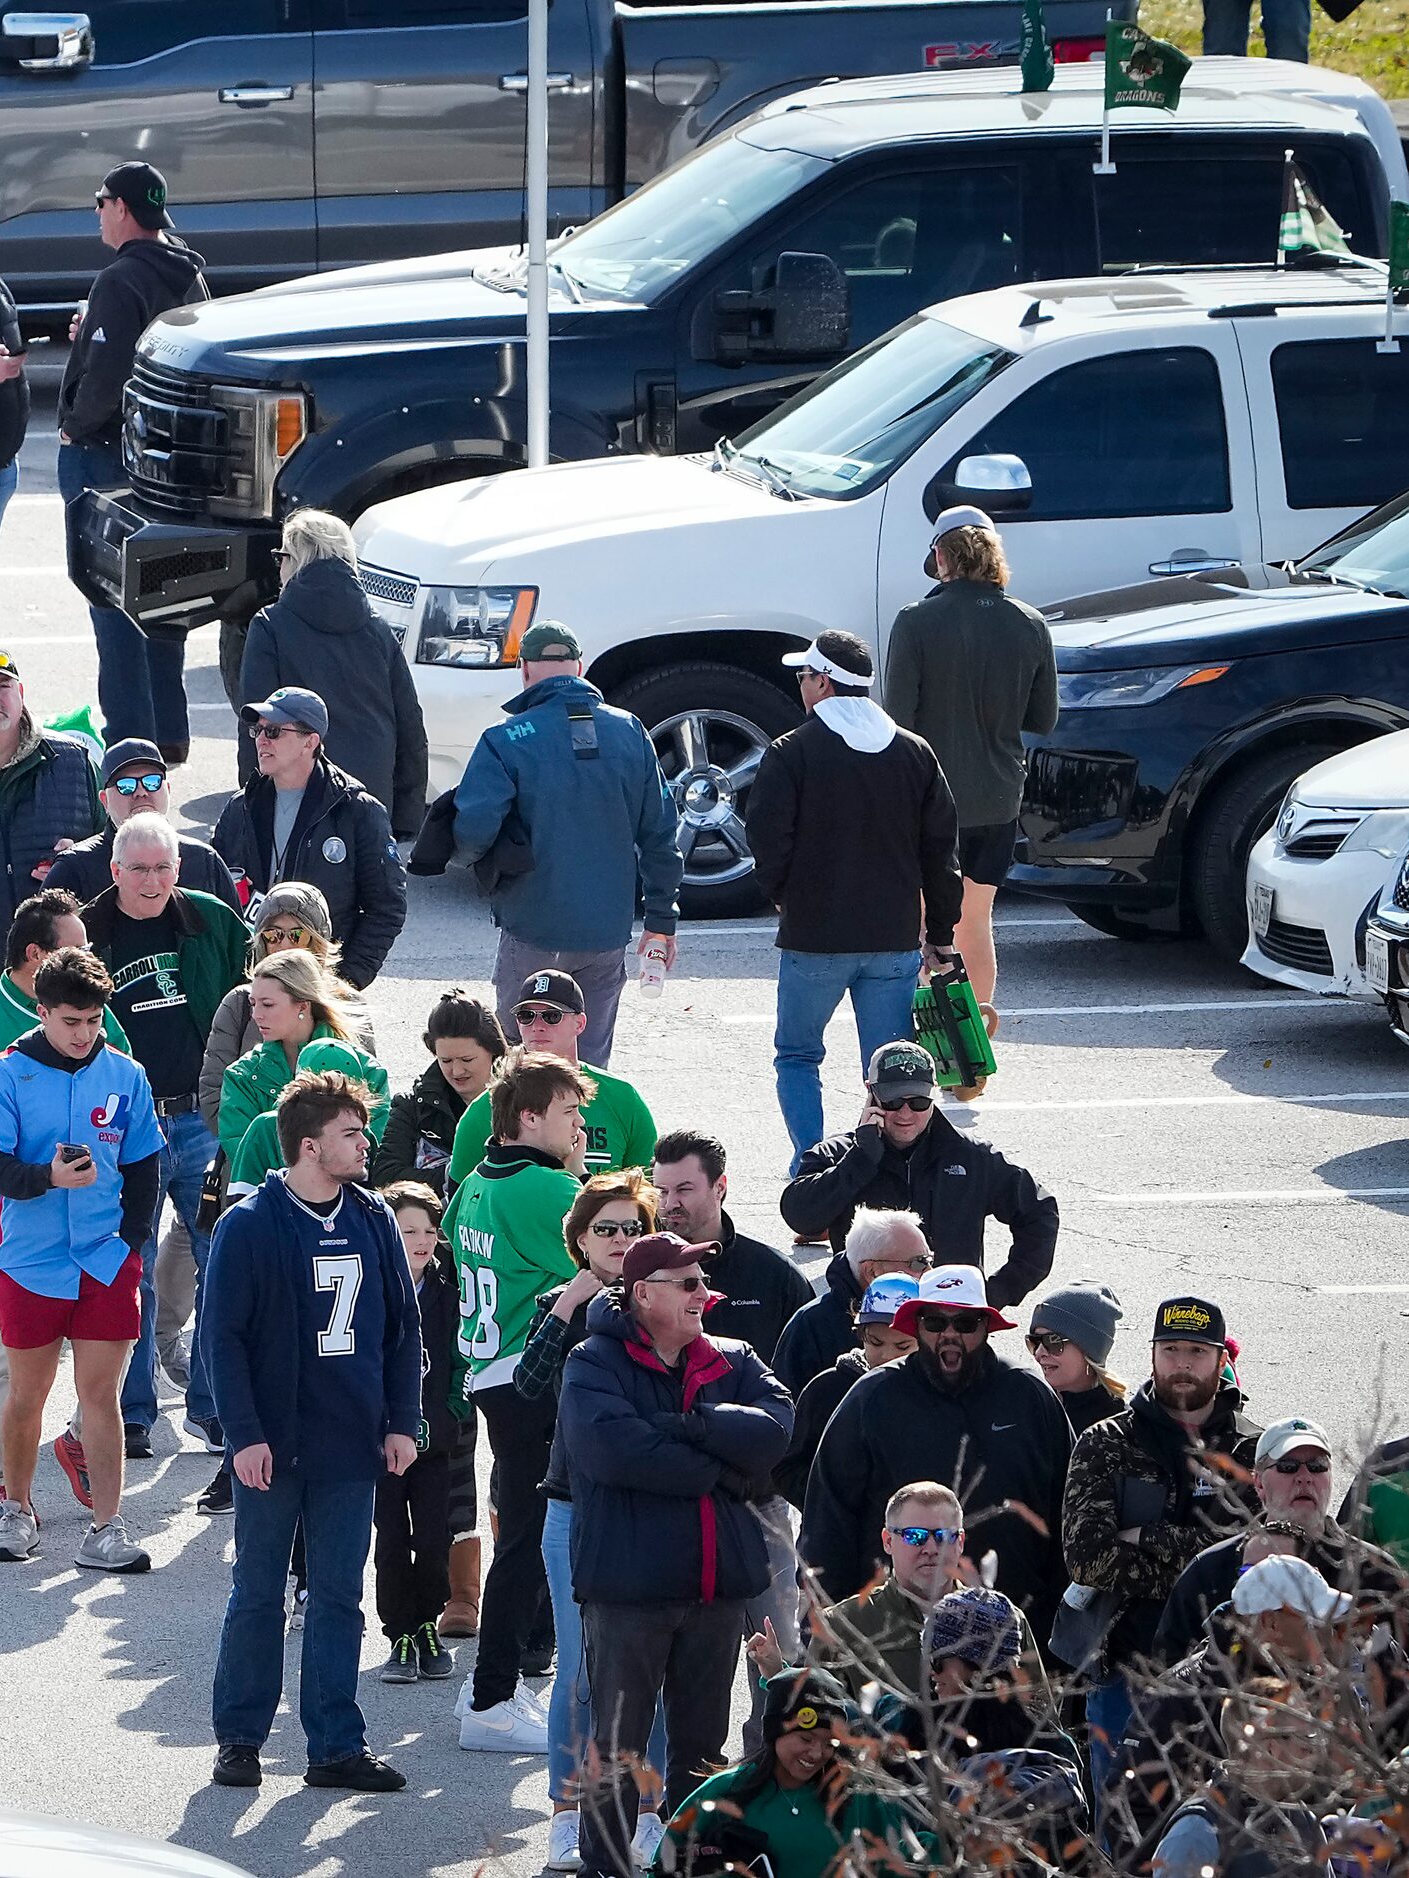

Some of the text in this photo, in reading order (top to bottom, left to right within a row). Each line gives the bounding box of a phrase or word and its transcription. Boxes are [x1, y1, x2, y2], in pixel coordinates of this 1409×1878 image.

[1115, 90, 1166, 104] DRAGONS
[505, 721, 536, 741] HH
[112, 955, 158, 992] CARROLL
[156, 972, 178, 997] SC
[132, 1000, 169, 1011] TRADITION
[312, 1254, 363, 1357] 7
[1163, 1304, 1211, 1327] Winnebago
